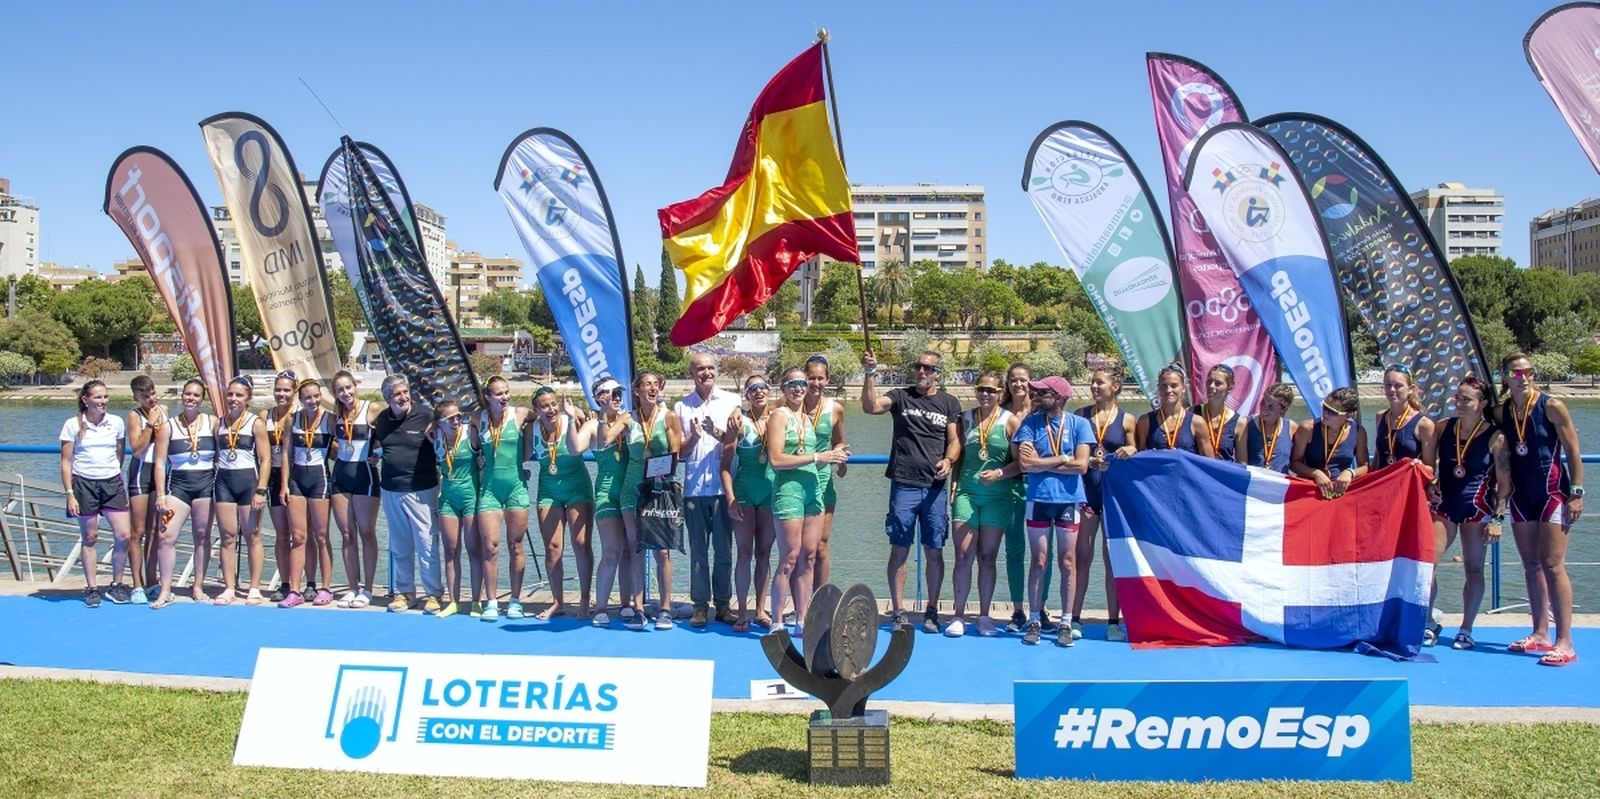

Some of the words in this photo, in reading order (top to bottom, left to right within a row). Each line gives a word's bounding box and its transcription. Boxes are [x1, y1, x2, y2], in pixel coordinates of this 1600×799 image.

[422, 674, 619, 712] LOTERÍAS
[431, 722, 475, 739] CON
[479, 724, 502, 741] EL
[507, 724, 600, 745] DEPORTE
[1053, 706, 1371, 757] #RemoEsp
